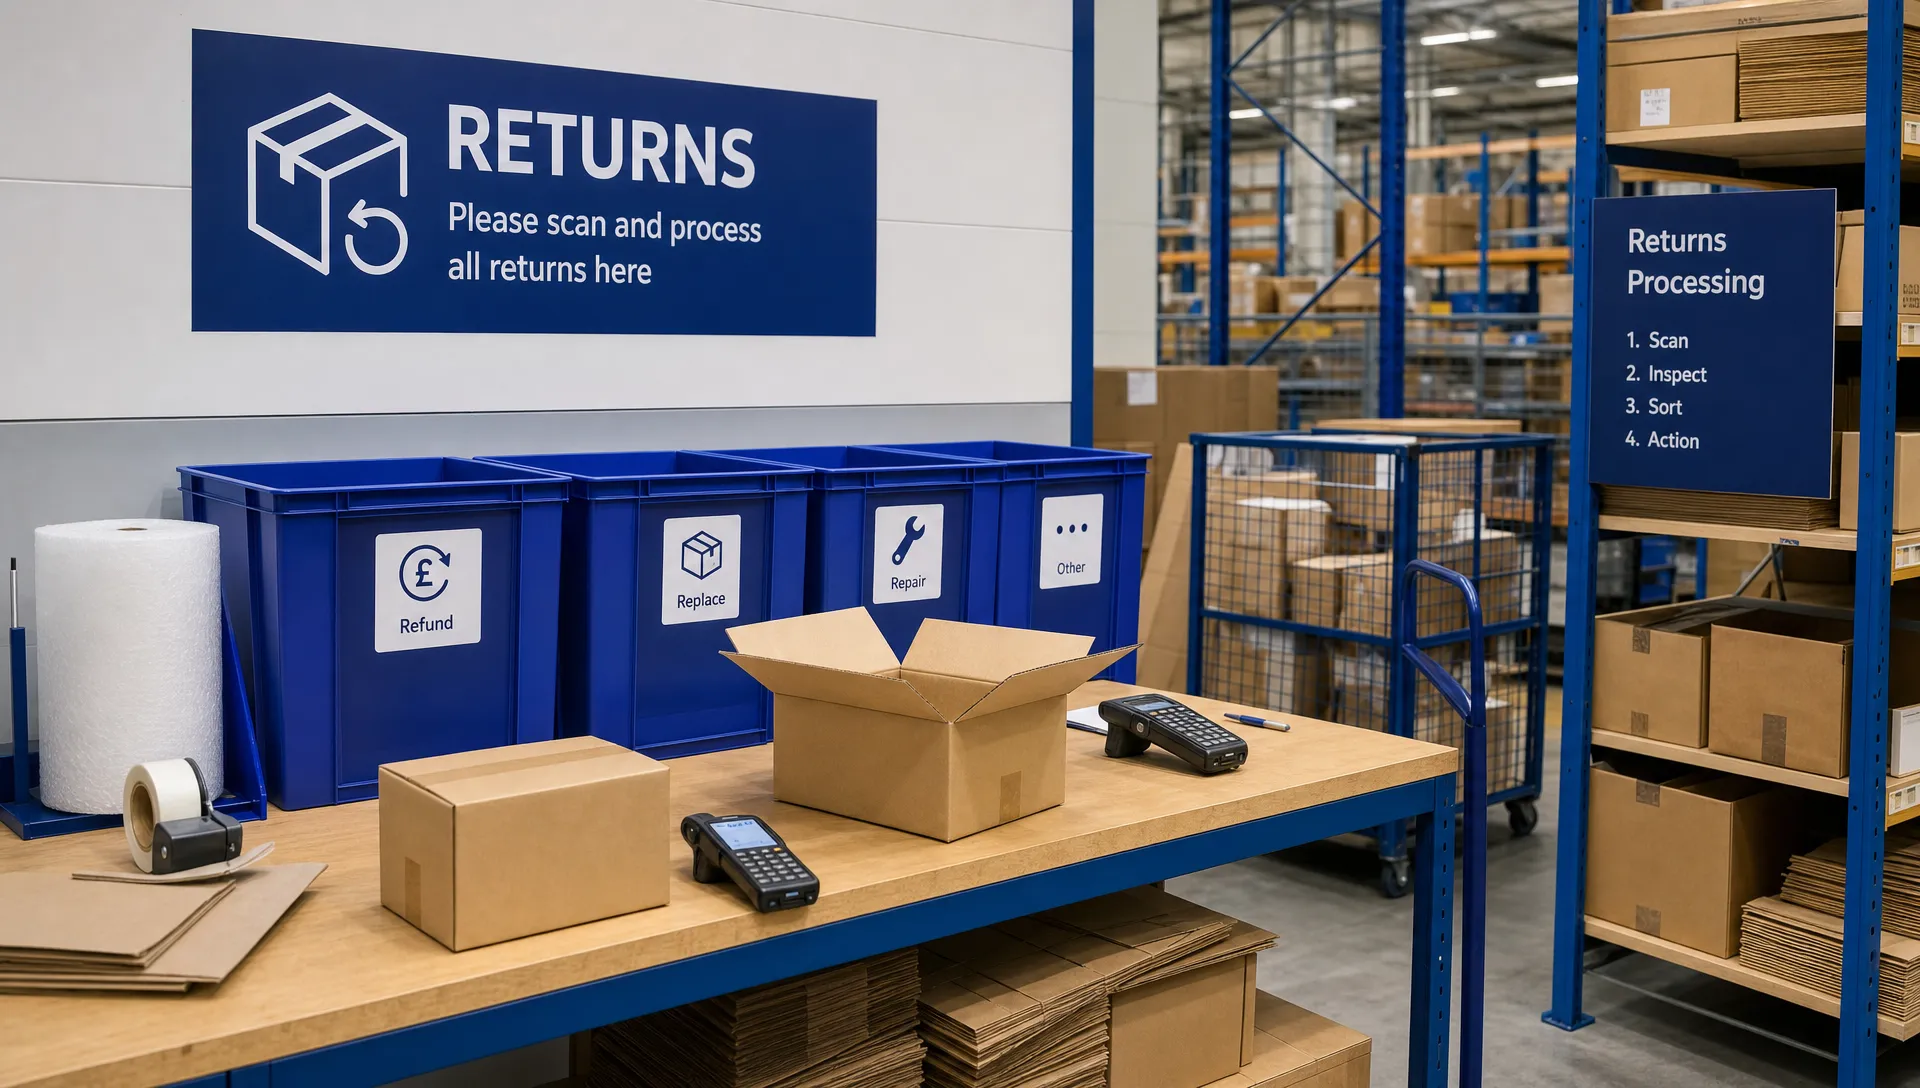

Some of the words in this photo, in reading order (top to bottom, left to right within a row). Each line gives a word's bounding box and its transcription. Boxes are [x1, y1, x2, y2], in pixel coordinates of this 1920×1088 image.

[448, 103, 756, 189] RETURNS
[448, 201, 539, 236] Please
[547, 212, 606, 237] scan
[614, 211, 662, 239] and
[670, 219, 762, 247] process
[1628, 228, 1727, 253] Returns
[448, 250, 481, 281] all
[490, 255, 587, 284] returns
[595, 254, 652, 285] here
[1628, 267, 1765, 300] Processing
[1627, 331, 1640, 349] 1.
[1649, 331, 1689, 349] Scan
[1626, 364, 1641, 382] 2.
[1649, 364, 1708, 387] Inspect
[1625, 397, 1640, 414] 3.
[1648, 397, 1683, 416] Sort
[1625, 430, 1640, 447] 4.
[1647, 430, 1700, 450] Action
[1057, 561, 1086, 575] Other
[891, 574, 927, 592] Repair
[677, 592, 726, 612] Replace
[400, 614, 454, 634] Refund
